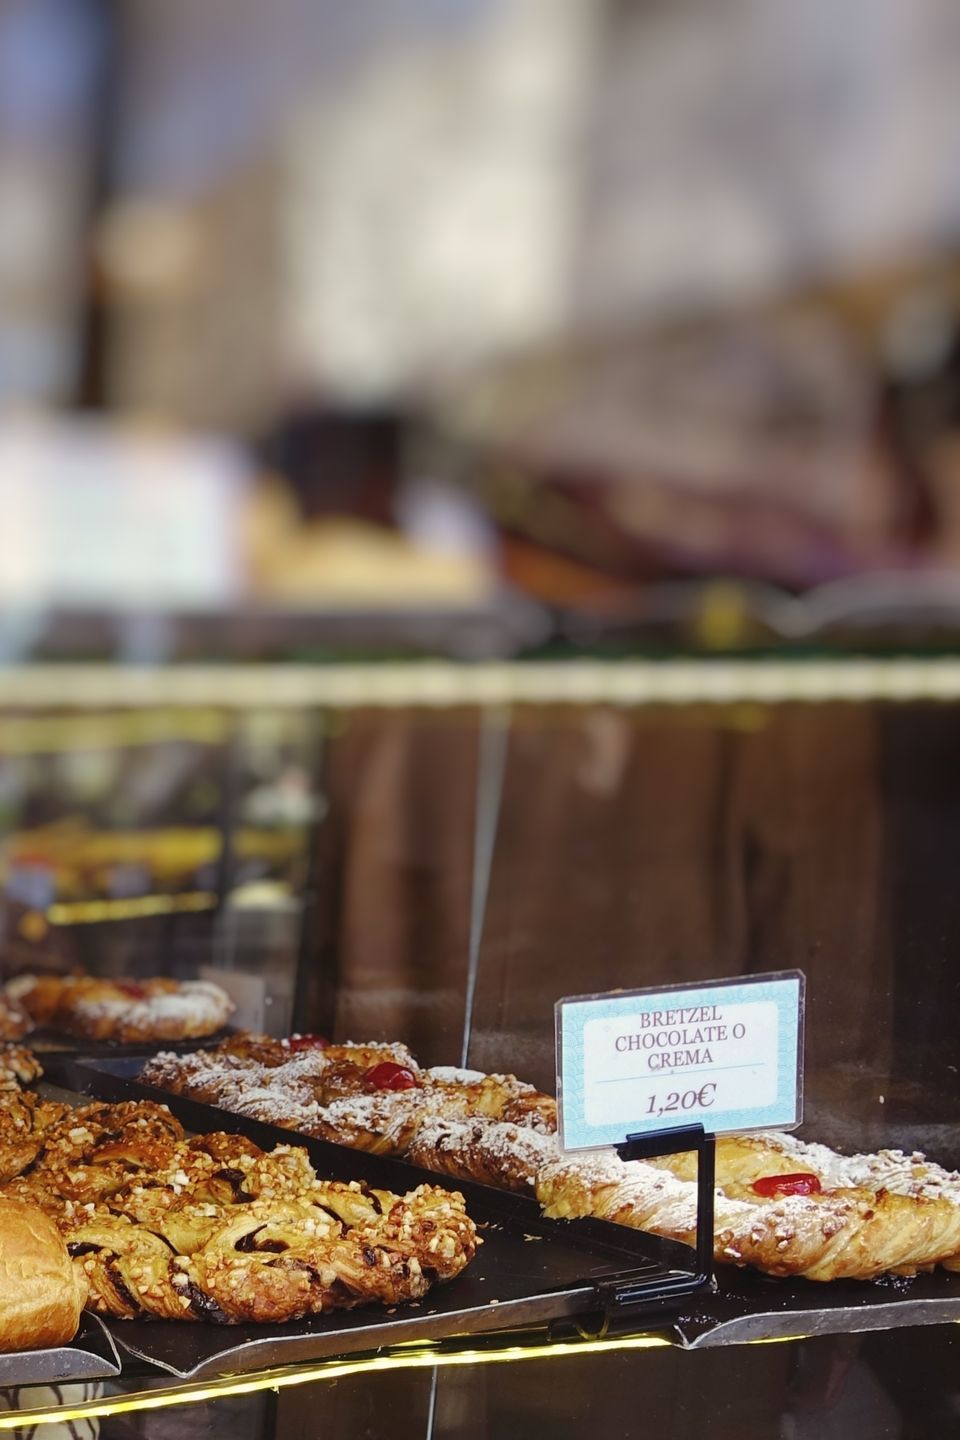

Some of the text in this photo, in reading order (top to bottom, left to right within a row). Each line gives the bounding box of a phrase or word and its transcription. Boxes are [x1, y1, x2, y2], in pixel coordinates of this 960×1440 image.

[640, 1005, 722, 1029] BRETZEL
[615, 1023, 746, 1052] CHOCOLATE O
[648, 1048, 713, 1069] CREMA
[645, 1082, 717, 1117] 1,20€
